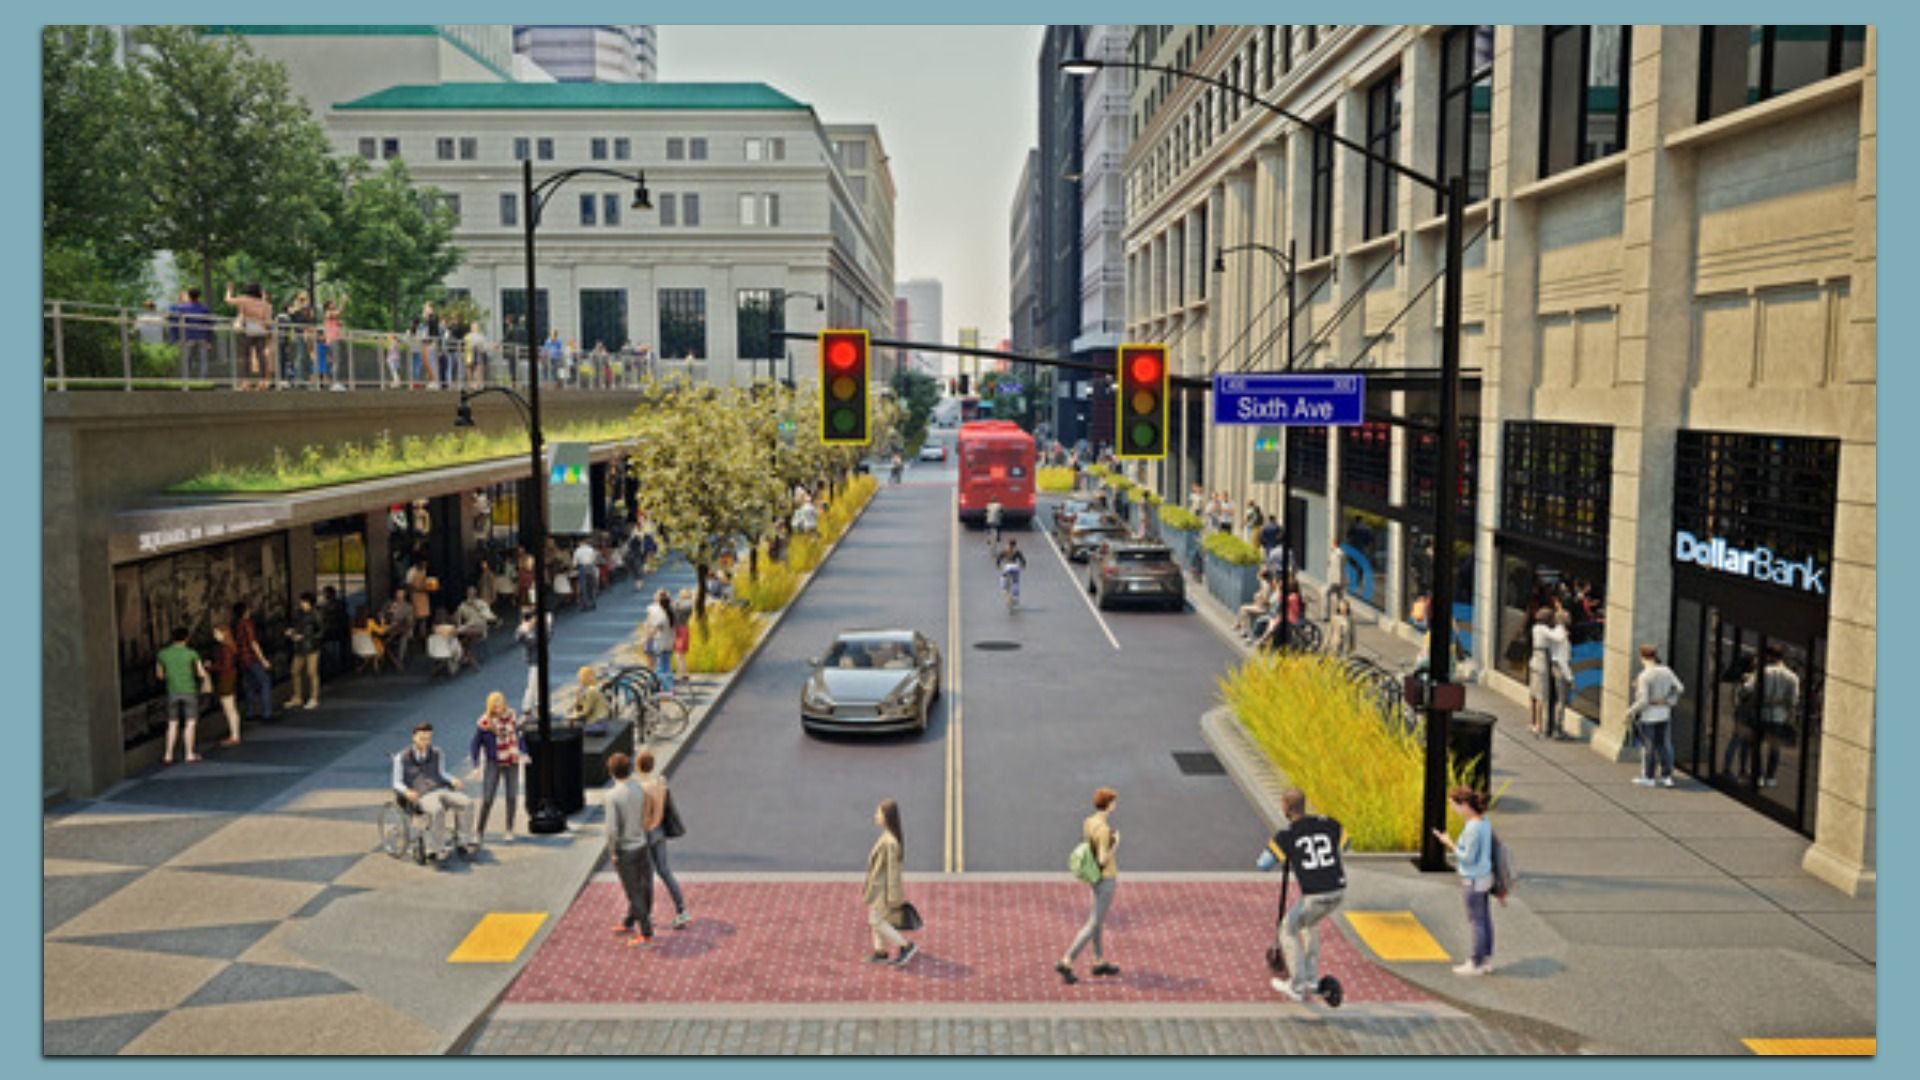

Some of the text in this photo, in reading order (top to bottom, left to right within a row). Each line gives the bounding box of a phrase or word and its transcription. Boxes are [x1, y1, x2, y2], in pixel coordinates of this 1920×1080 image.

[1237, 397, 1334, 420] Sixth Ave
[1295, 833, 1335, 870] 32
